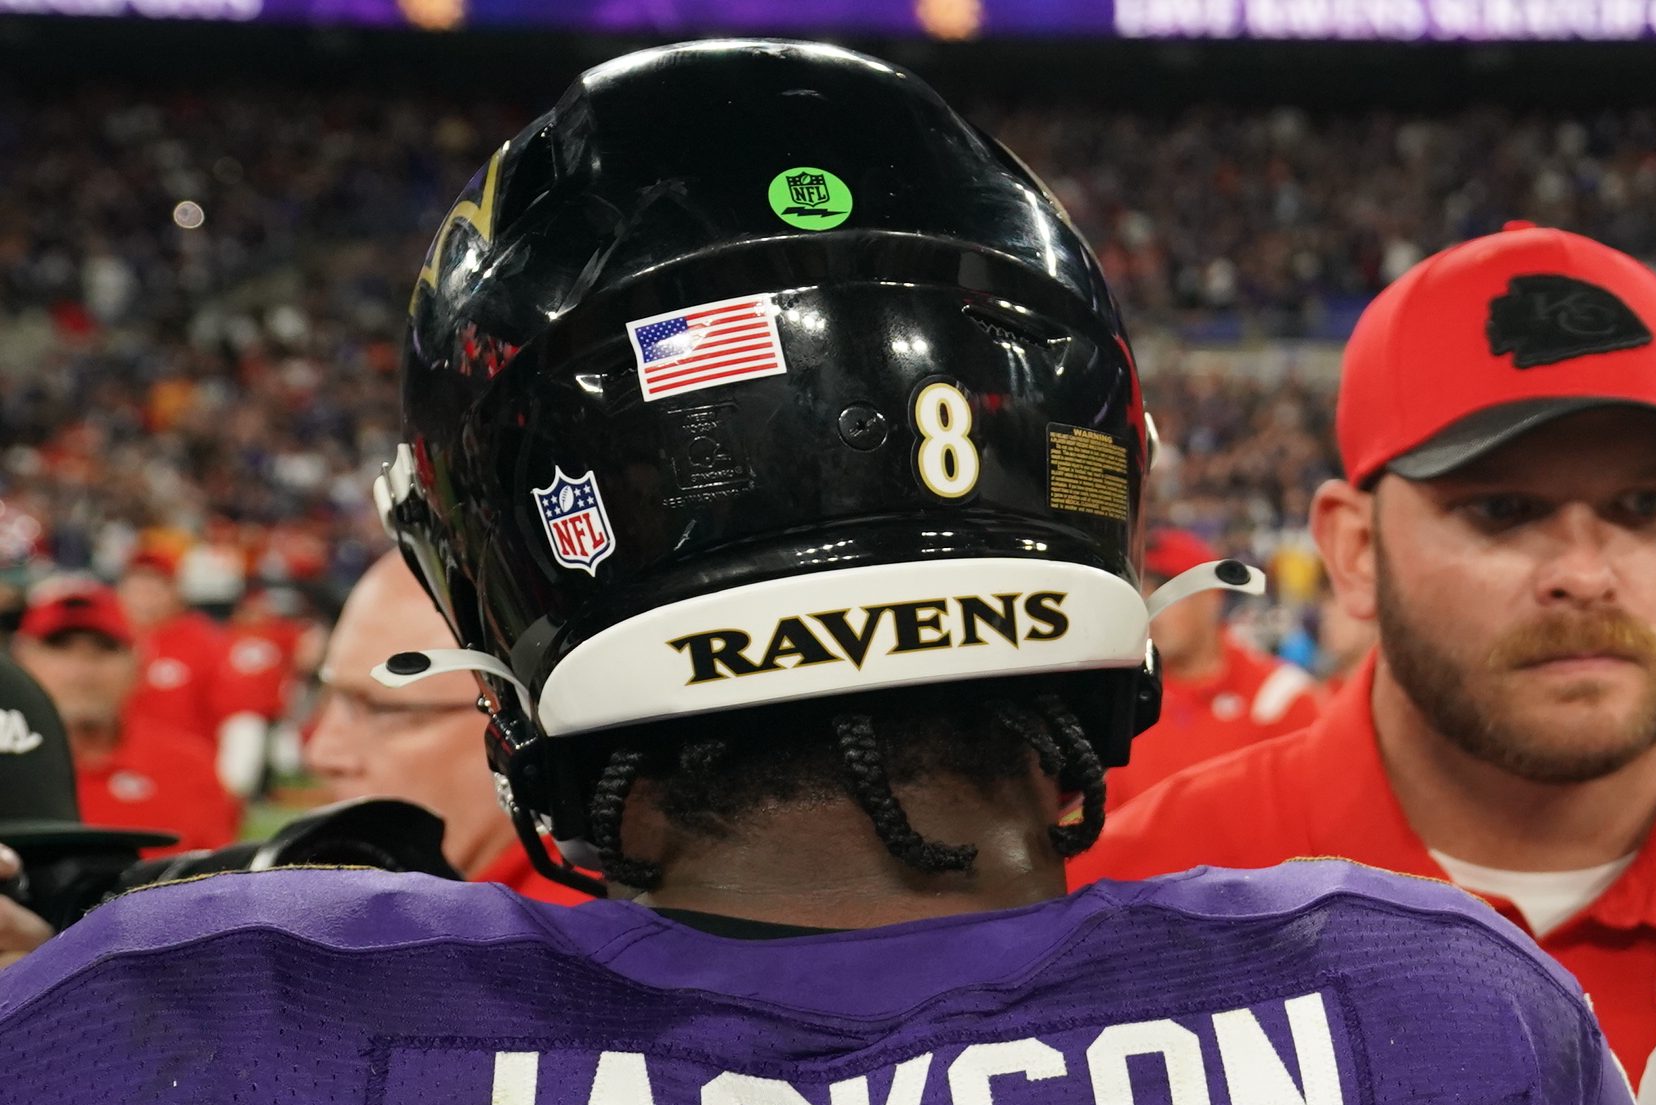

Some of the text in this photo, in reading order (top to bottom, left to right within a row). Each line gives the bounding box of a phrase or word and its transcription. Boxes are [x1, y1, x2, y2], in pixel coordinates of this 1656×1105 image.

[793, 185, 826, 203] NFL
[914, 382, 980, 498] 8
[1073, 427, 1113, 444] WARNING
[552, 512, 605, 557] NFL
[666, 591, 1070, 686] RAVENS
